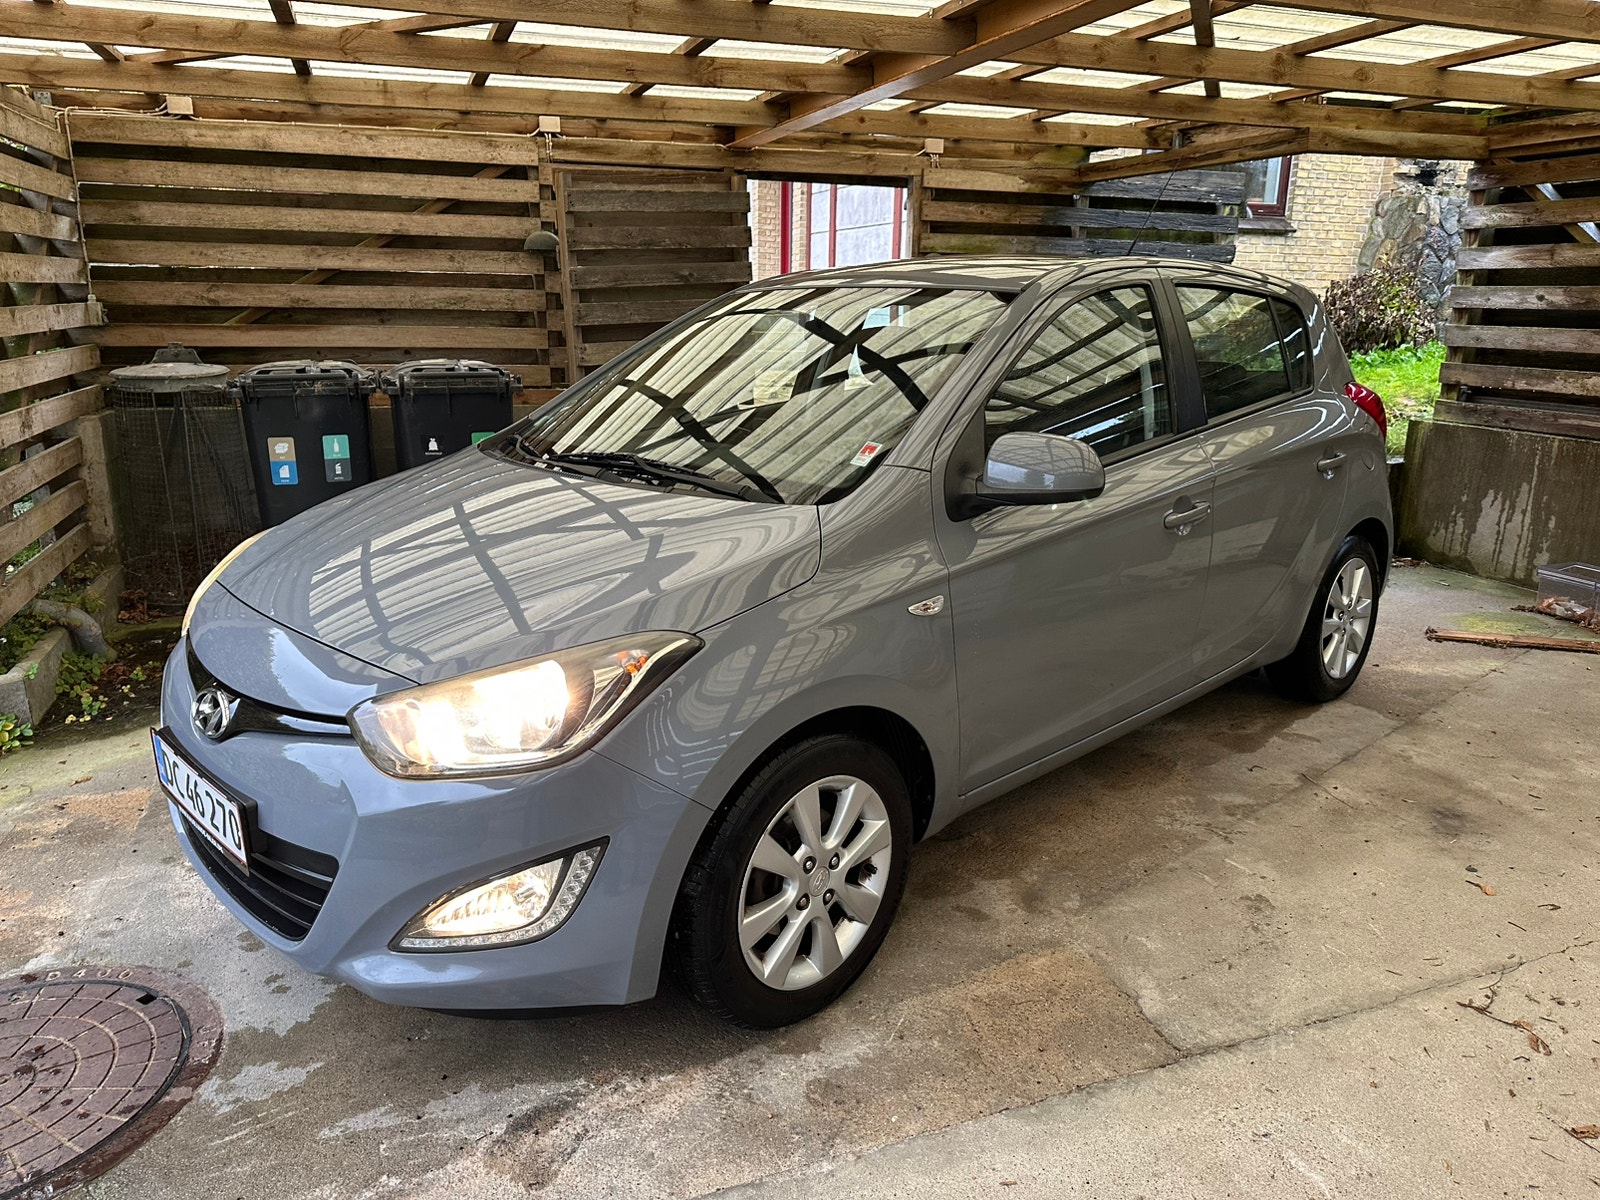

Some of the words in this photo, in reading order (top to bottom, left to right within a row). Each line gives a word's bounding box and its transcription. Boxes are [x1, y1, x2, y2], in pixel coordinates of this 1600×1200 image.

[162, 748, 185, 799] DC
[186, 773, 205, 818] 46
[204, 789, 241, 850] 270
